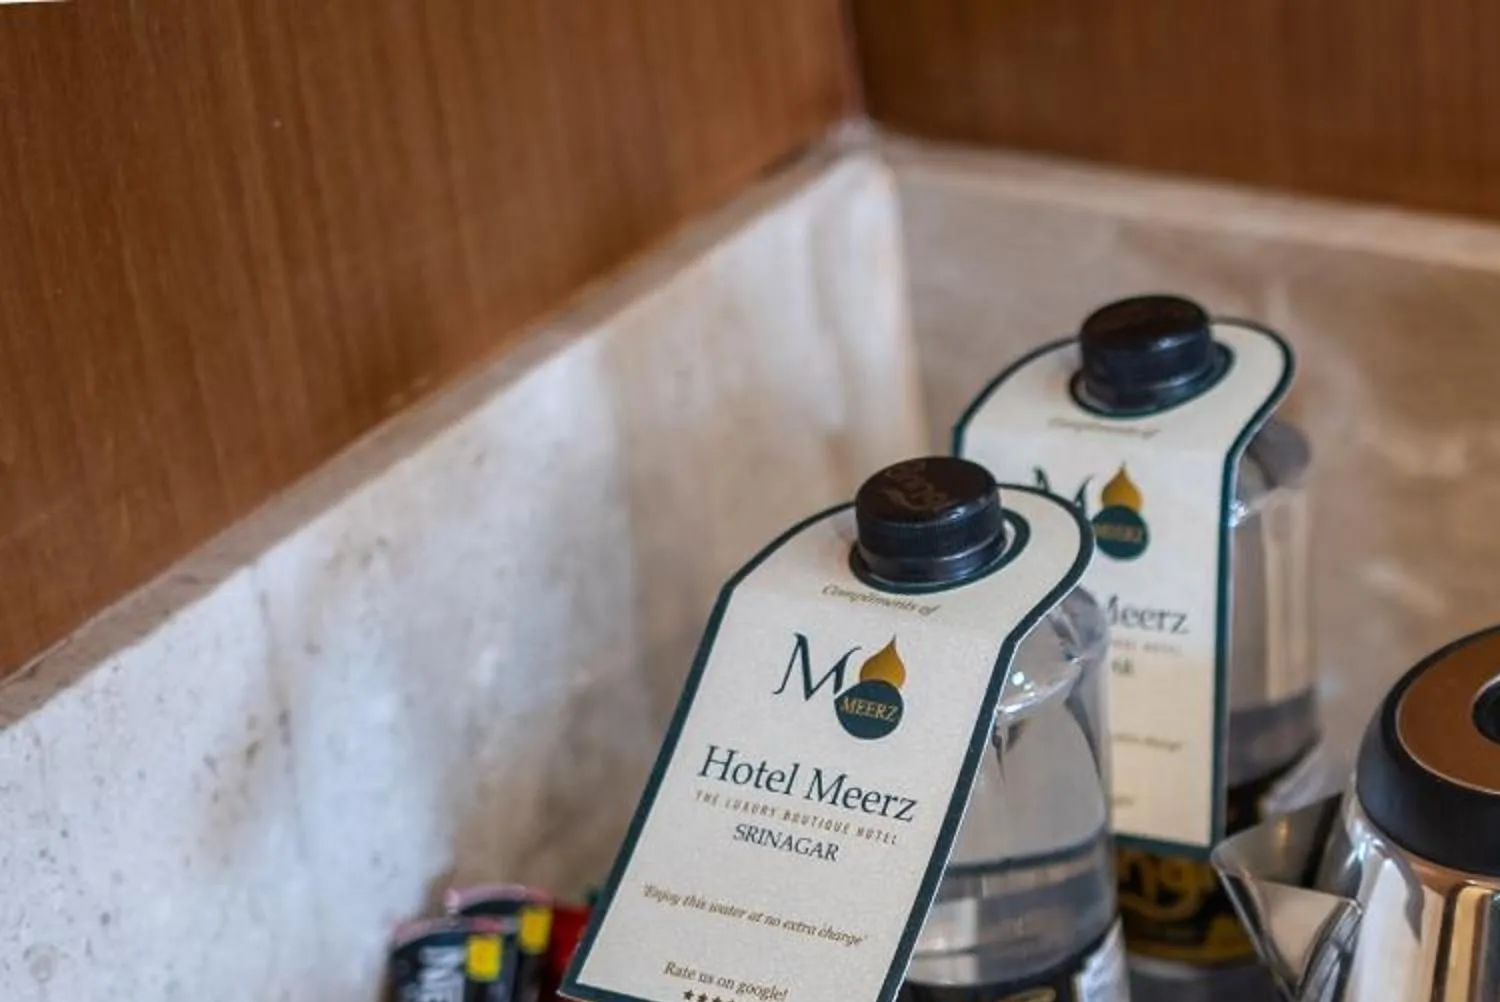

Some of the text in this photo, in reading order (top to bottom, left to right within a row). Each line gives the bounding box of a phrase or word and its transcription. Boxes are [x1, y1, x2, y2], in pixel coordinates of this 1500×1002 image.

[841, 698, 899, 723] MEERZ
[697, 745, 918, 823] Hotel Meerz
[695, 790, 898, 846] THE LUXURY BOUTIQUE HOTEL
[733, 823, 840, 862] SRINAGAR
[682, 894, 706, 911] this
[708, 904, 748, 920] water
[748, 911, 764, 924] at
[764, 915, 781, 928] no
[782, 920, 817, 937] extra
[663, 961, 789, 1002] Rate us on google!
